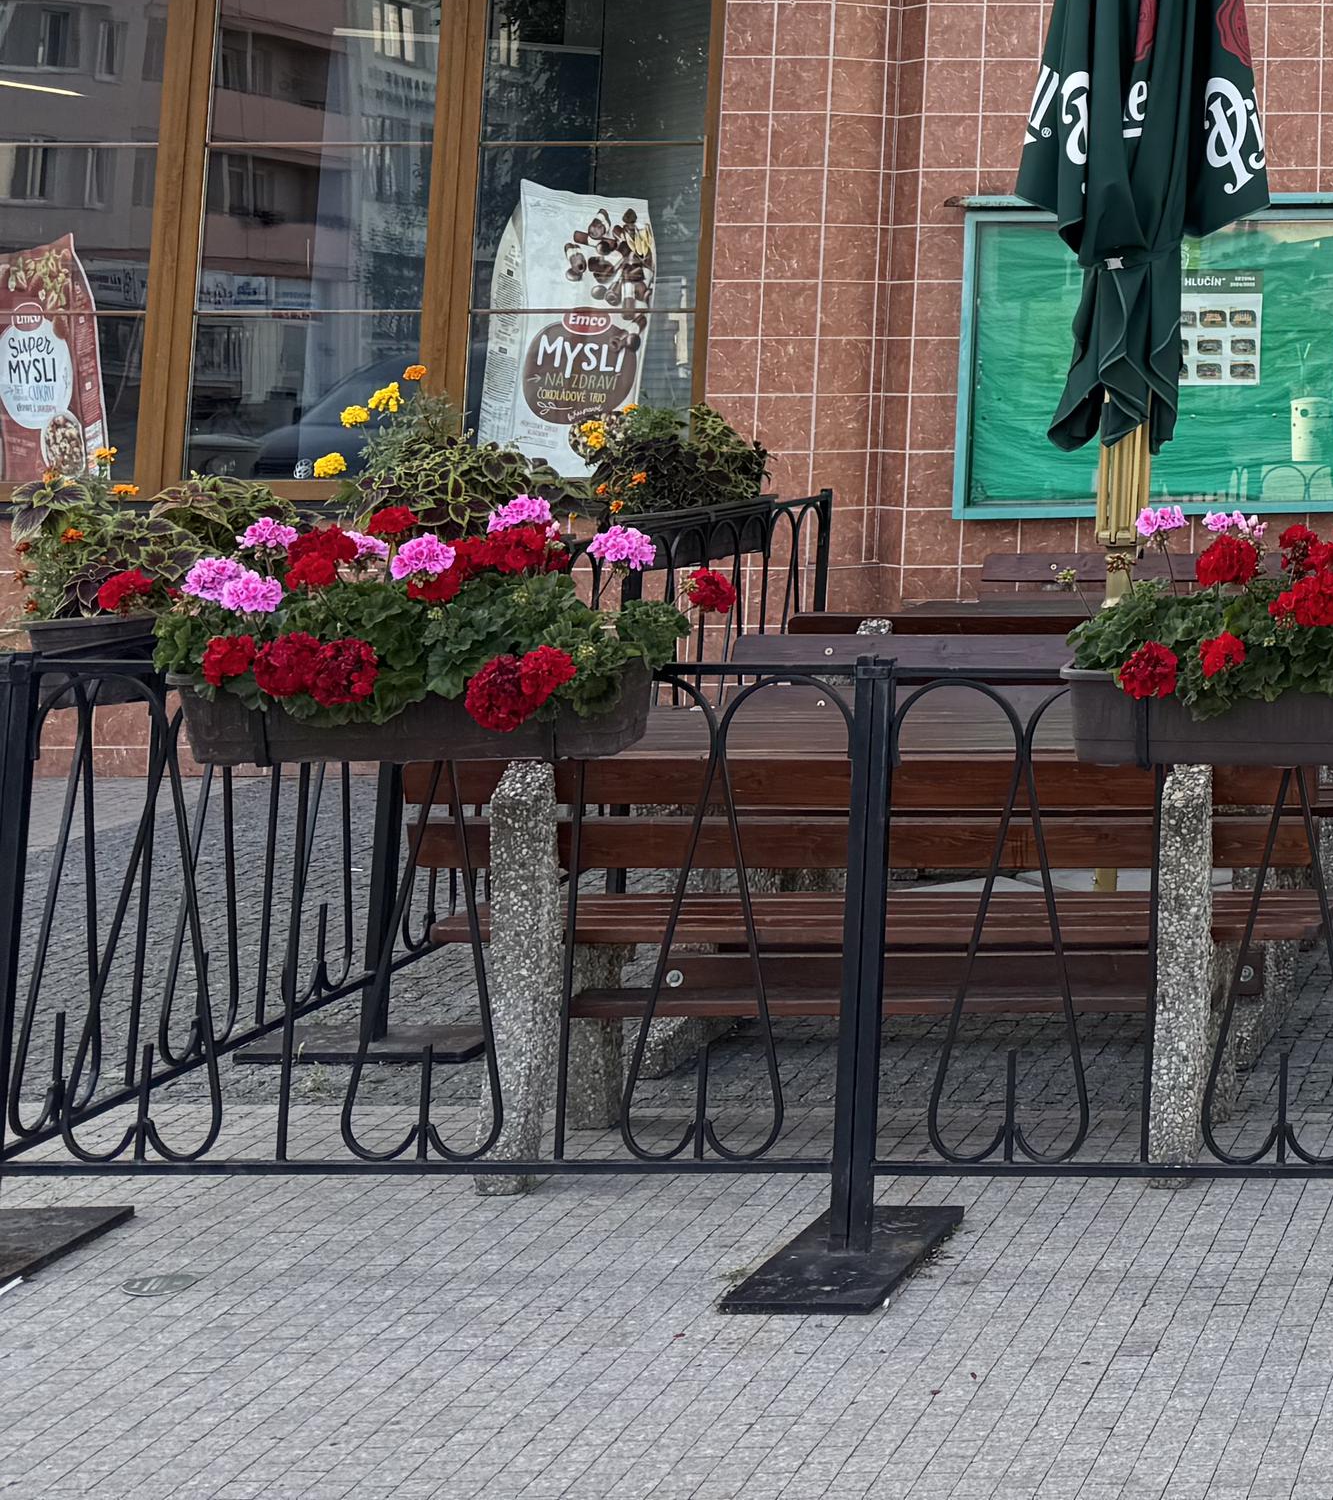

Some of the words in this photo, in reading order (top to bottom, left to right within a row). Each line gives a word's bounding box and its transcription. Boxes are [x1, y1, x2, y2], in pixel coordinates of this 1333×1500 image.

[568, 313, 608, 327] Emco
[536, 334, 626, 379] MYSLI
[8, 357, 57, 385] MYSLI
[544, 372, 564, 387] NA
[571, 372, 622, 391] ZDRAVÍ
[589, 391, 607, 404] TRIO
